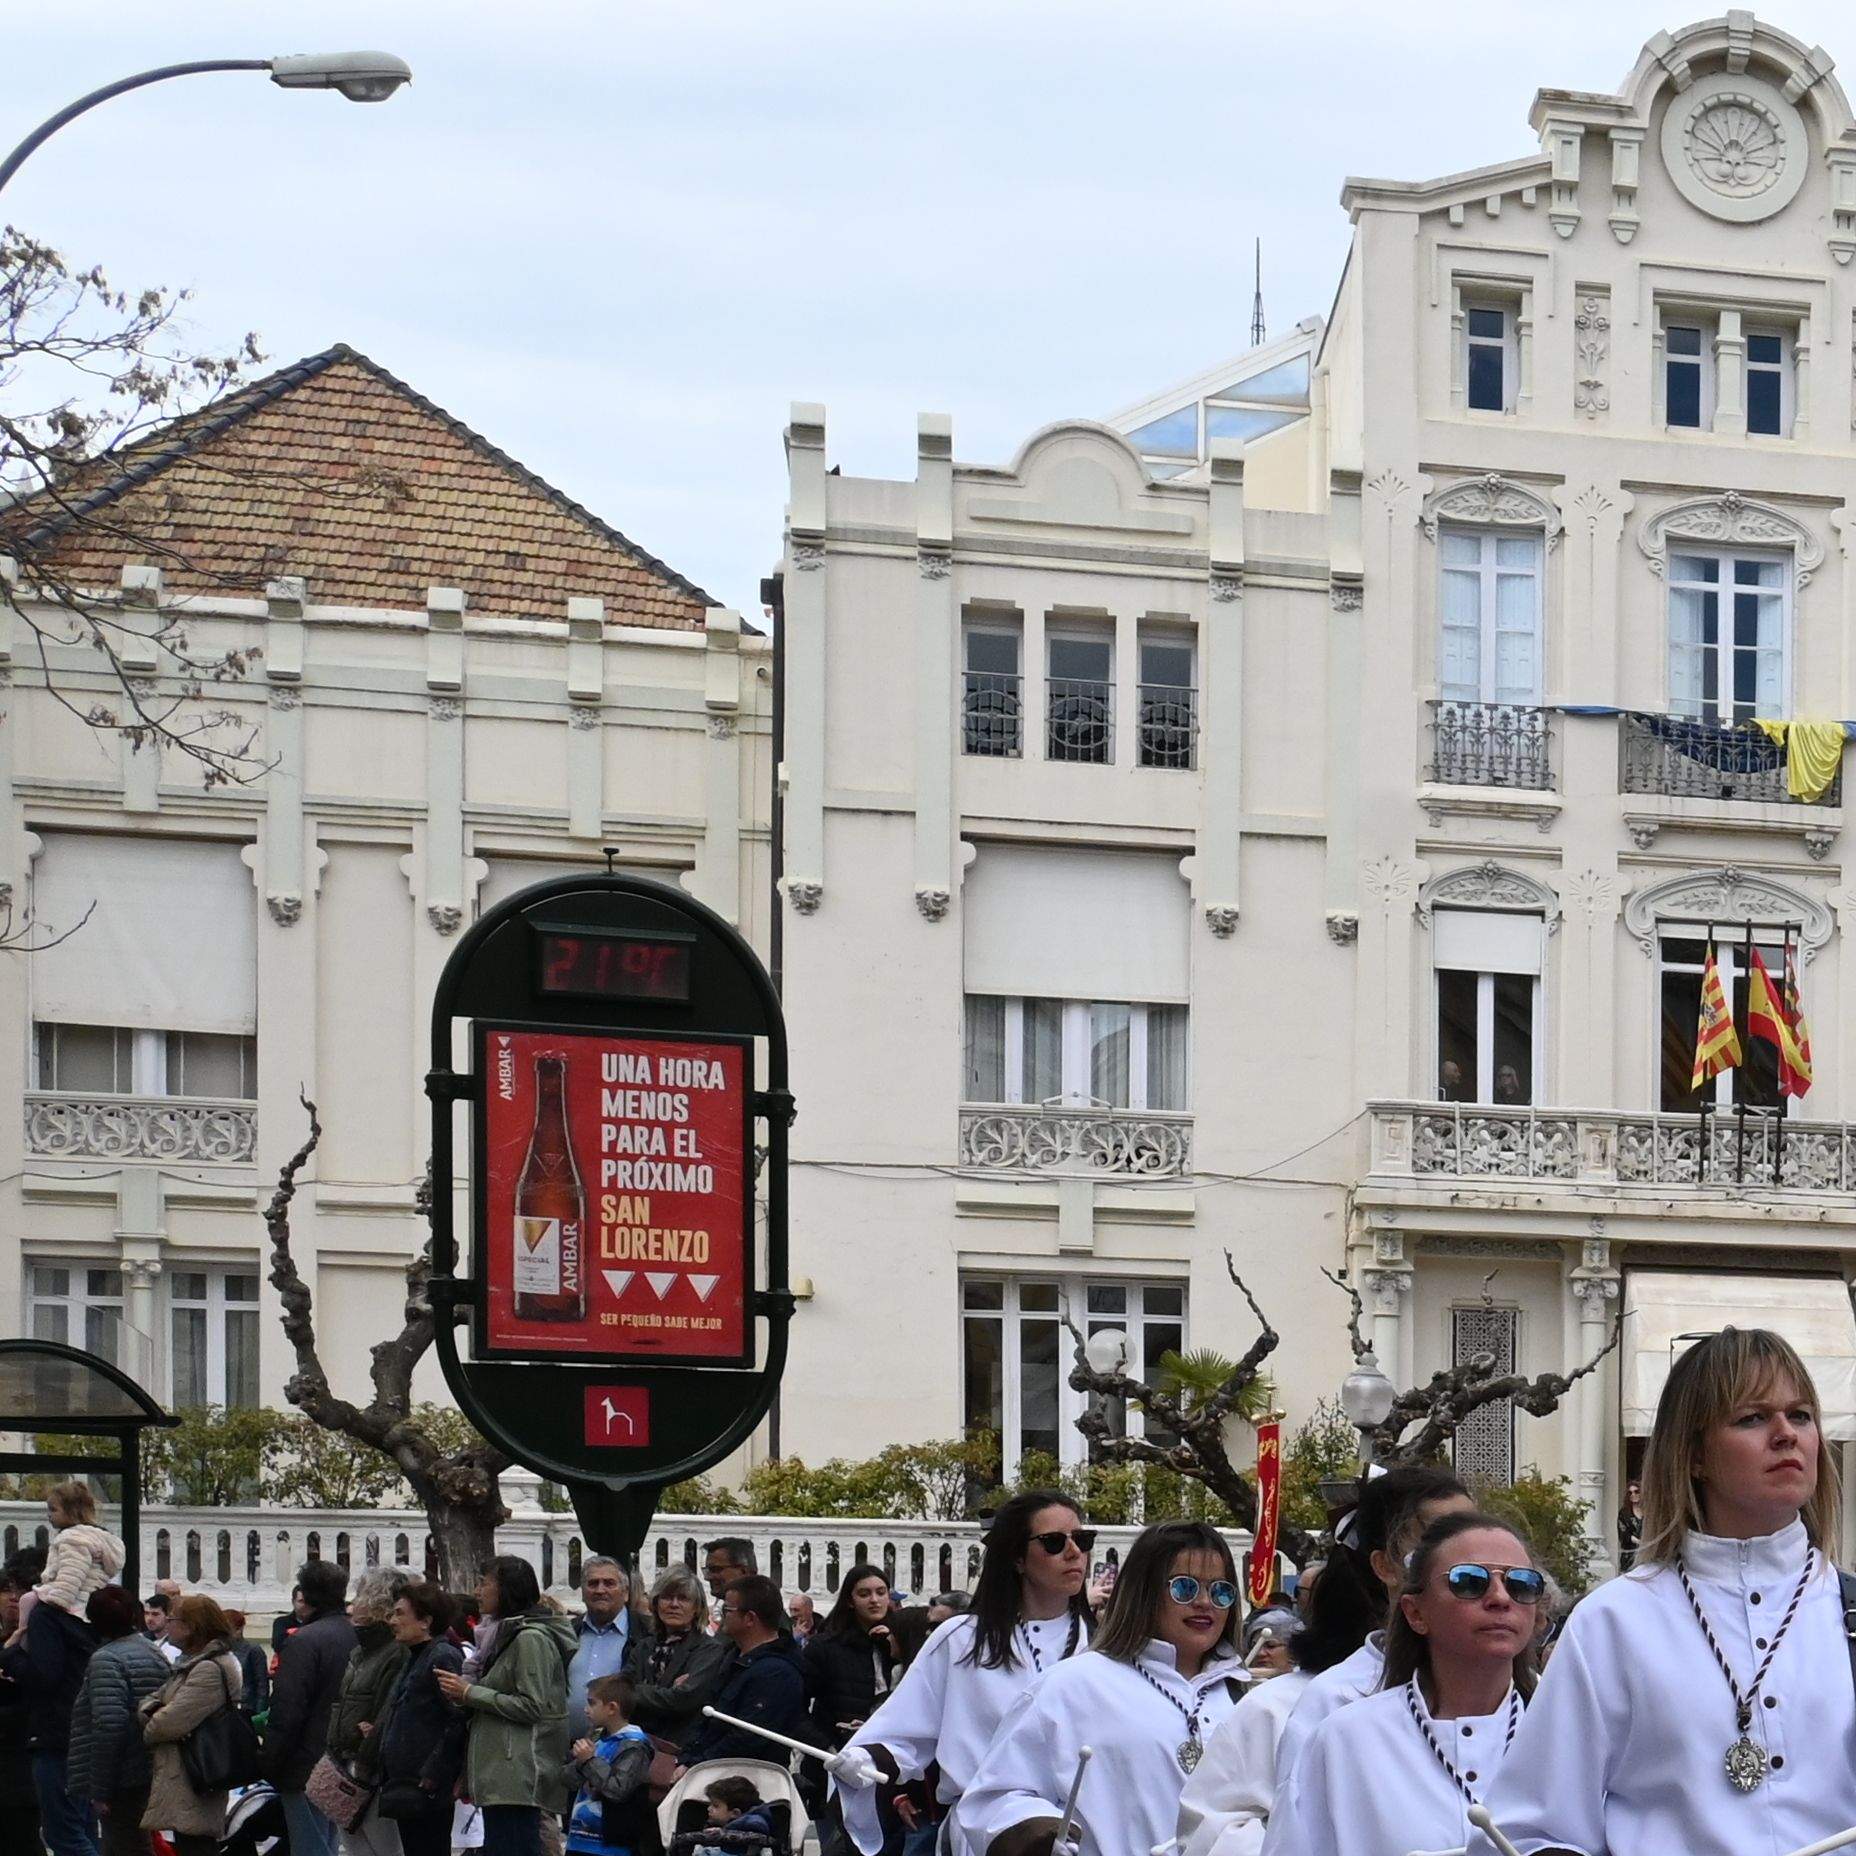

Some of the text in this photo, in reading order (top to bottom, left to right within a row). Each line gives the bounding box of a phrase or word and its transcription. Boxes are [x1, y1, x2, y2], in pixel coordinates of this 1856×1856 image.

[499, 1048, 513, 1101] AMBAR
[602, 1053, 725, 1090] UNA HORA
[602, 1088, 689, 1123] MENOS
[601, 1124, 703, 1158] PARA EL
[601, 1156, 713, 1194] PRÓXIMO
[601, 1194, 650, 1225] SAN
[563, 1222, 578, 1292] AMBAR
[601, 1226, 709, 1264] LORENZO
[600, 1313, 618, 1326] SER
[691, 1317, 722, 1330] MEJOR
